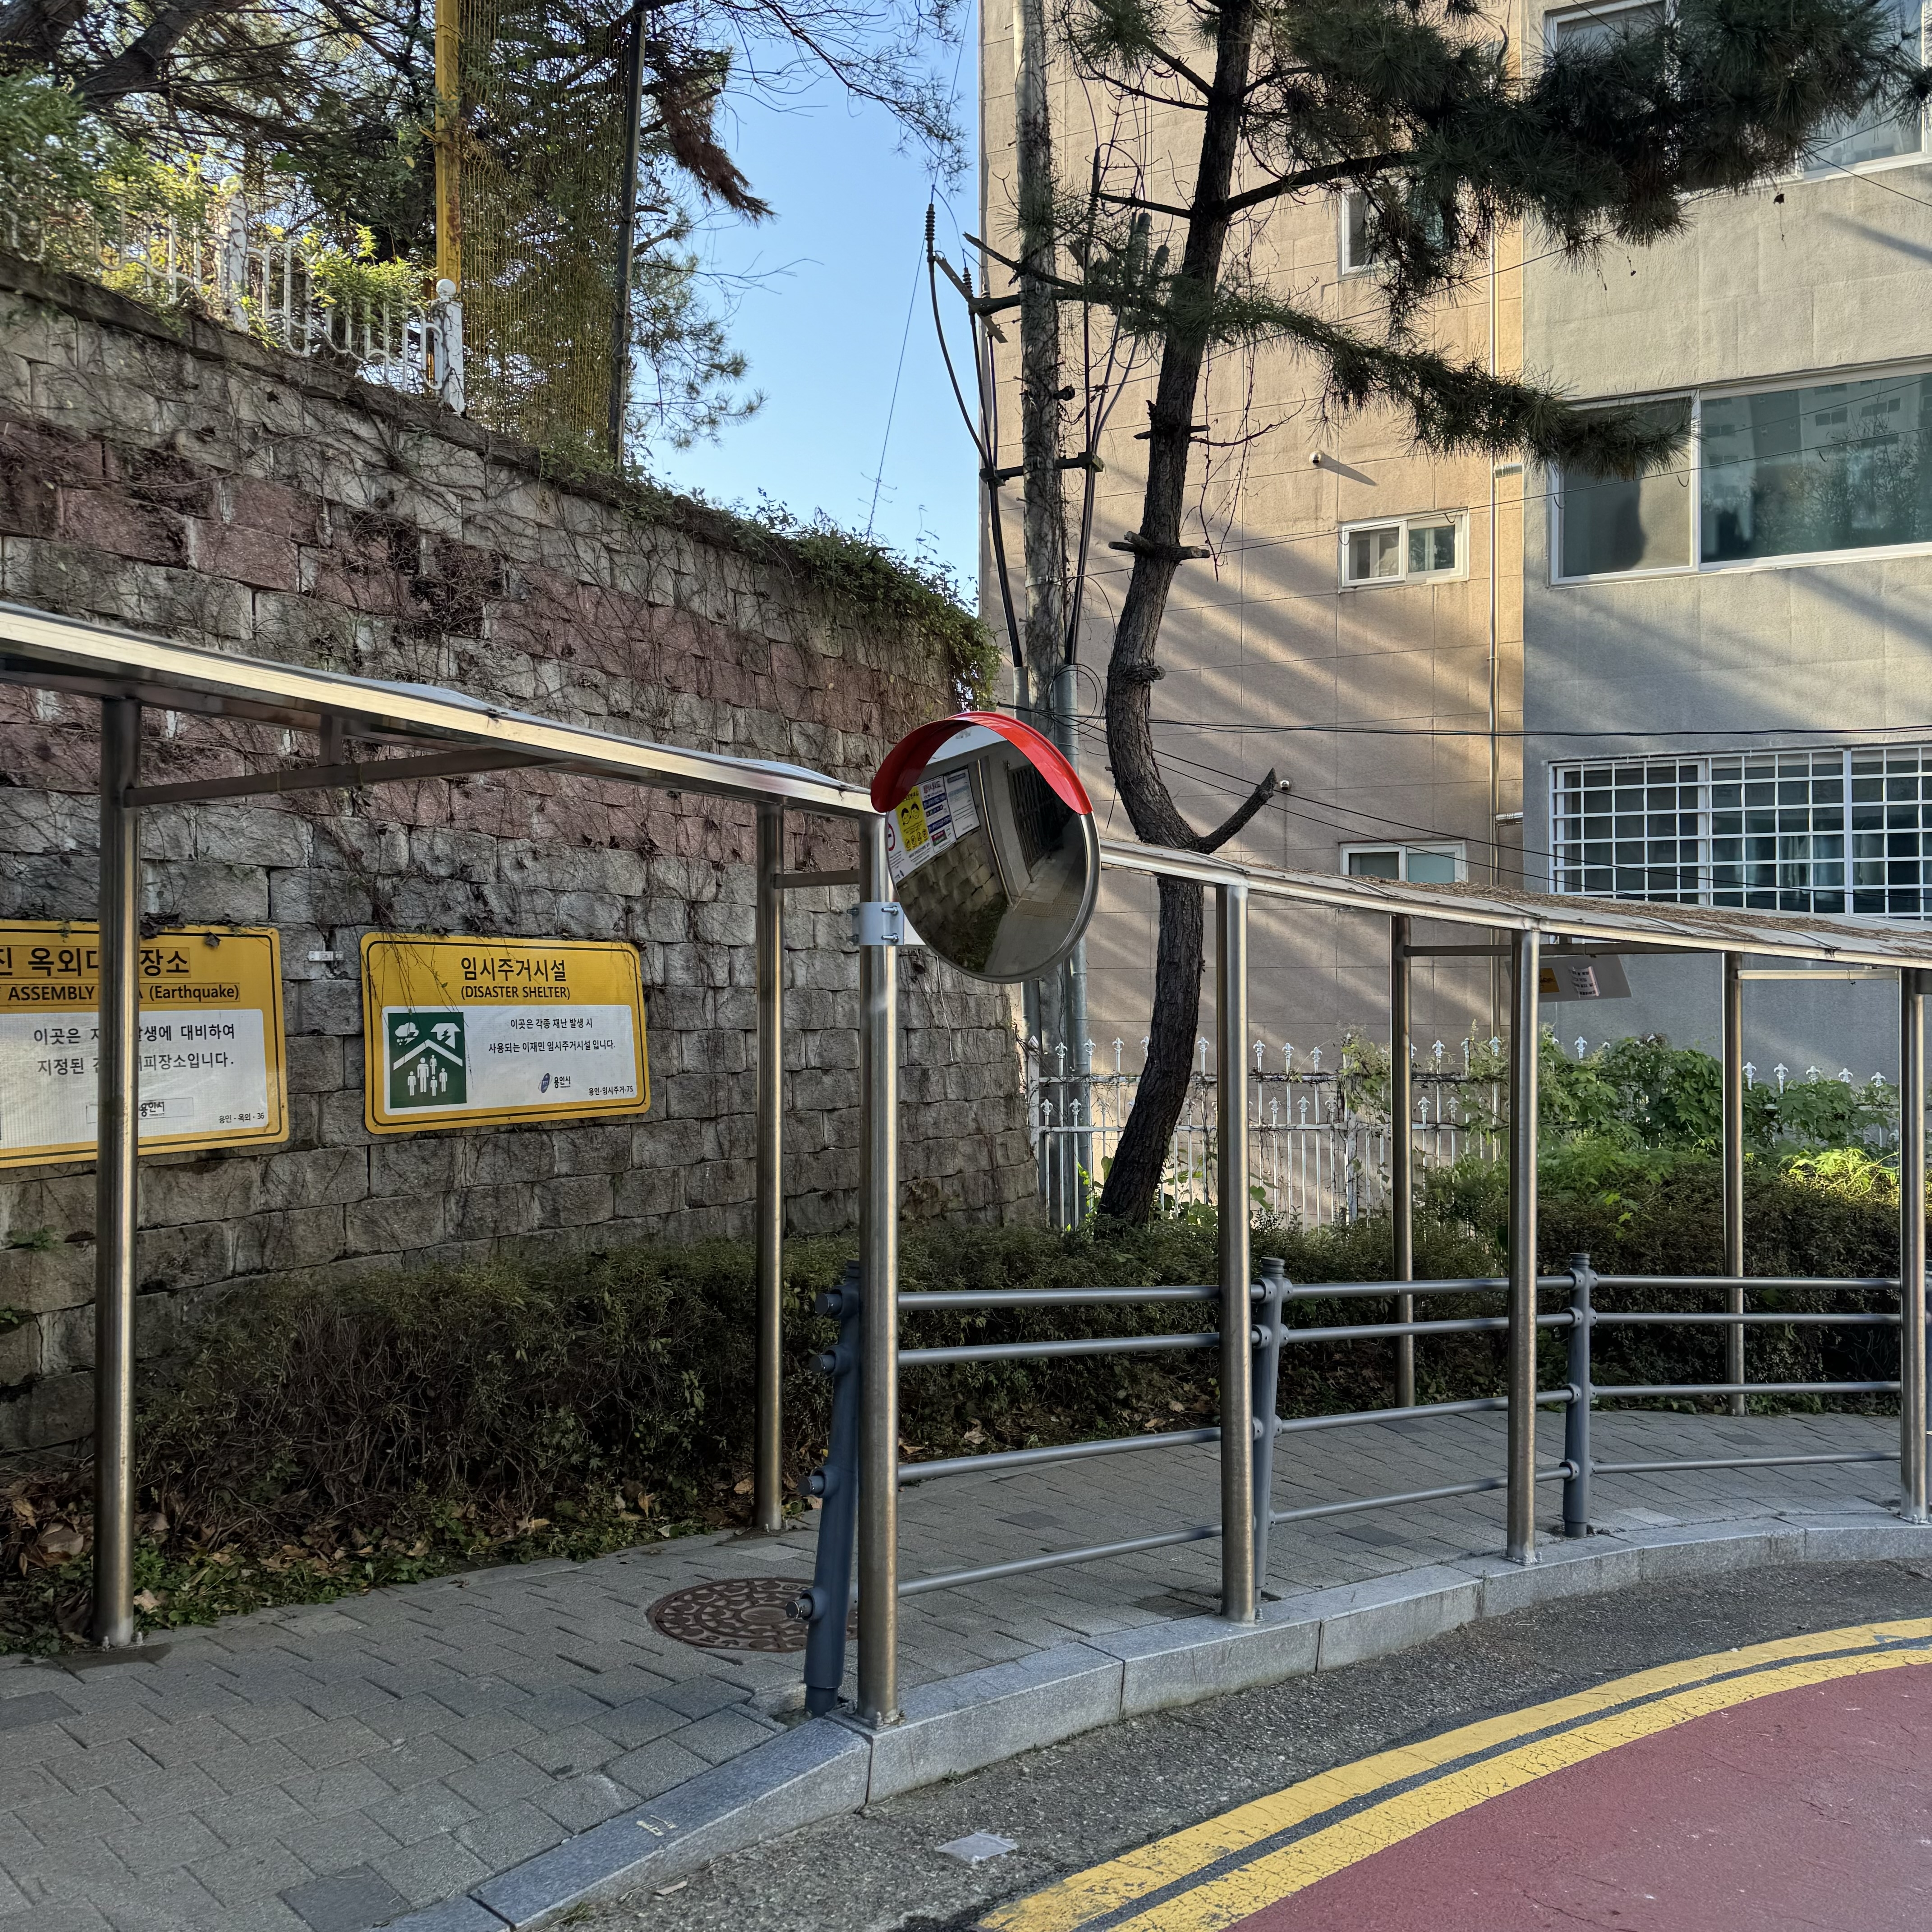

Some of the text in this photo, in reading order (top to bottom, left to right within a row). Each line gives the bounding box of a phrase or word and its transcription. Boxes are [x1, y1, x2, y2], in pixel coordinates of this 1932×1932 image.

[28, 948, 189, 976] 옥외장소
[461, 957, 566, 982] 임시주거시설
[8, 986, 95, 1001] ASSEMBLY
[149, 984, 239, 1002] (Earthquake)
[461, 986, 570, 1000] (DISASTER SHELTER)
[511, 1018, 593, 1030] 이곳은 각종 재난 발생 시
[34, 1028, 81, 1045] 이곳은
[180, 1023, 235, 1041] 대비하여
[488, 1040, 616, 1053] 사용되는 이재민 임시주거시설 입니다.
[37, 1057, 84, 1076] 지정된
[553, 1076, 571, 1089] 용인시
[138, 1101, 165, 1117] 용인시
